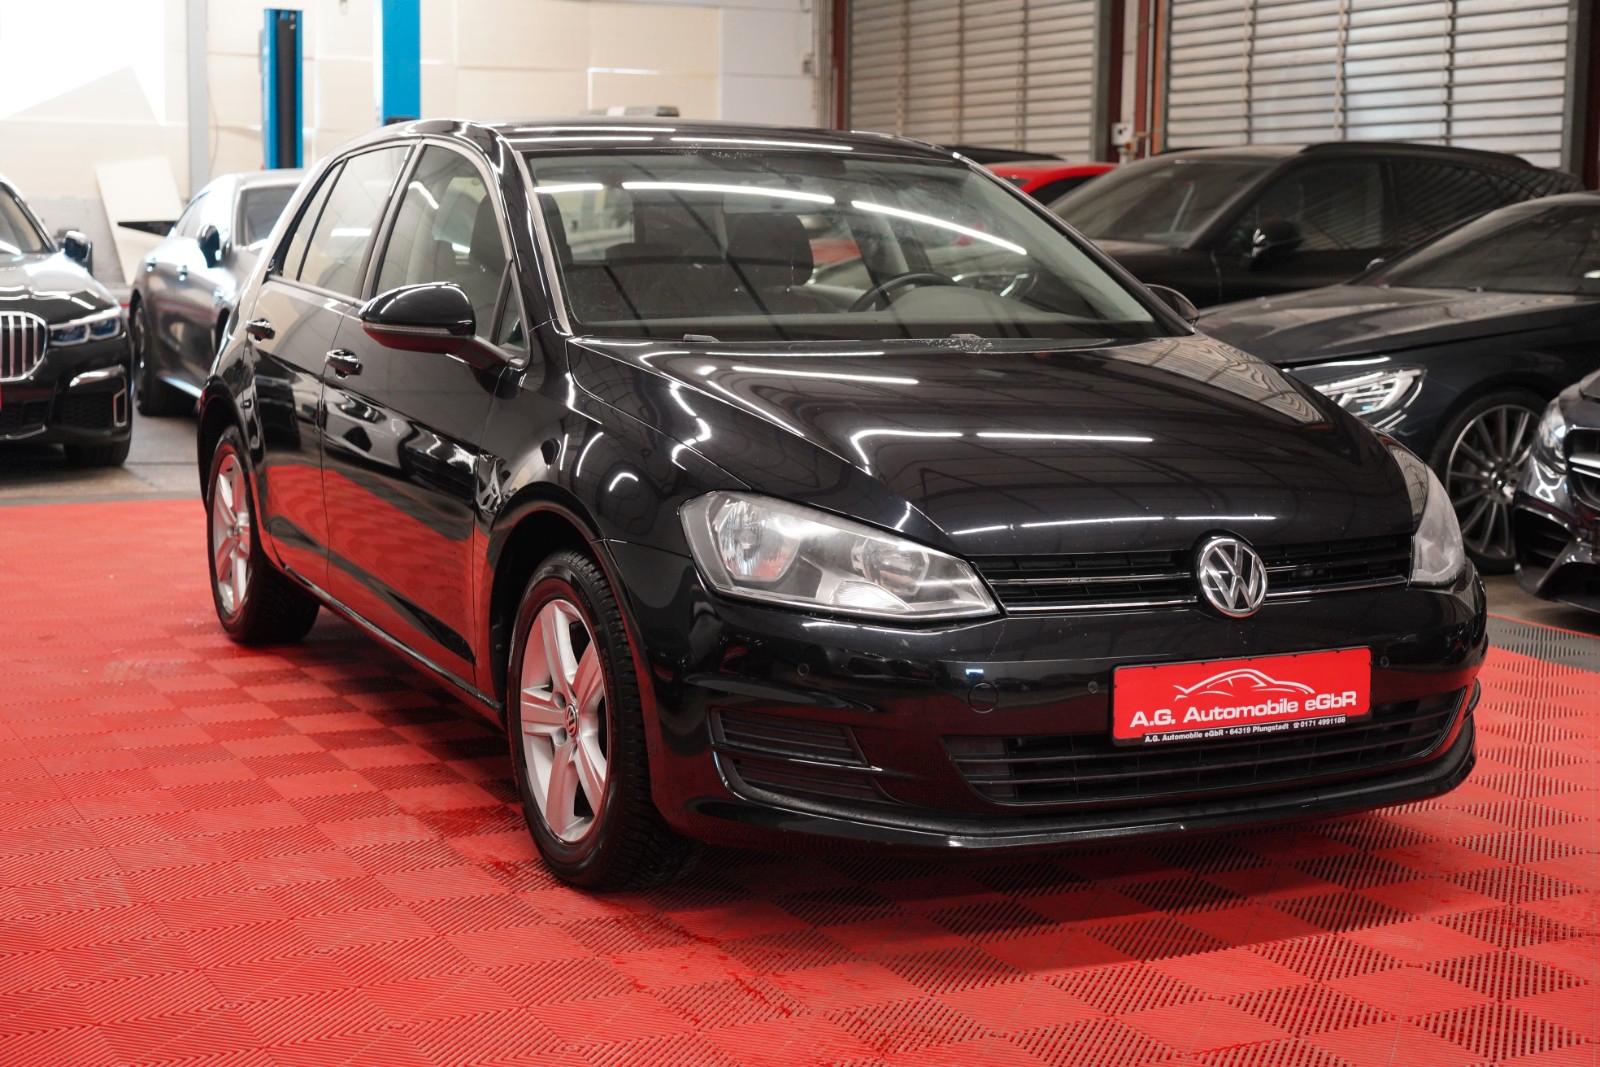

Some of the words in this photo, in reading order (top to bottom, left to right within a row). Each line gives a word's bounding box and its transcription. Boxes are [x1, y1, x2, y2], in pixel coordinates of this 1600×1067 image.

[1129, 709, 1176, 728] A.G.
[1183, 698, 1299, 723] Automobile
[1304, 691, 1357, 711] eGbR
[1144, 734, 1160, 743] A.G.
[1162, 731, 1203, 742] Automobile
[1204, 729, 1224, 738] eGbR
[1229, 727, 1251, 736] 64319
[1300, 720, 1316, 728] 0171
